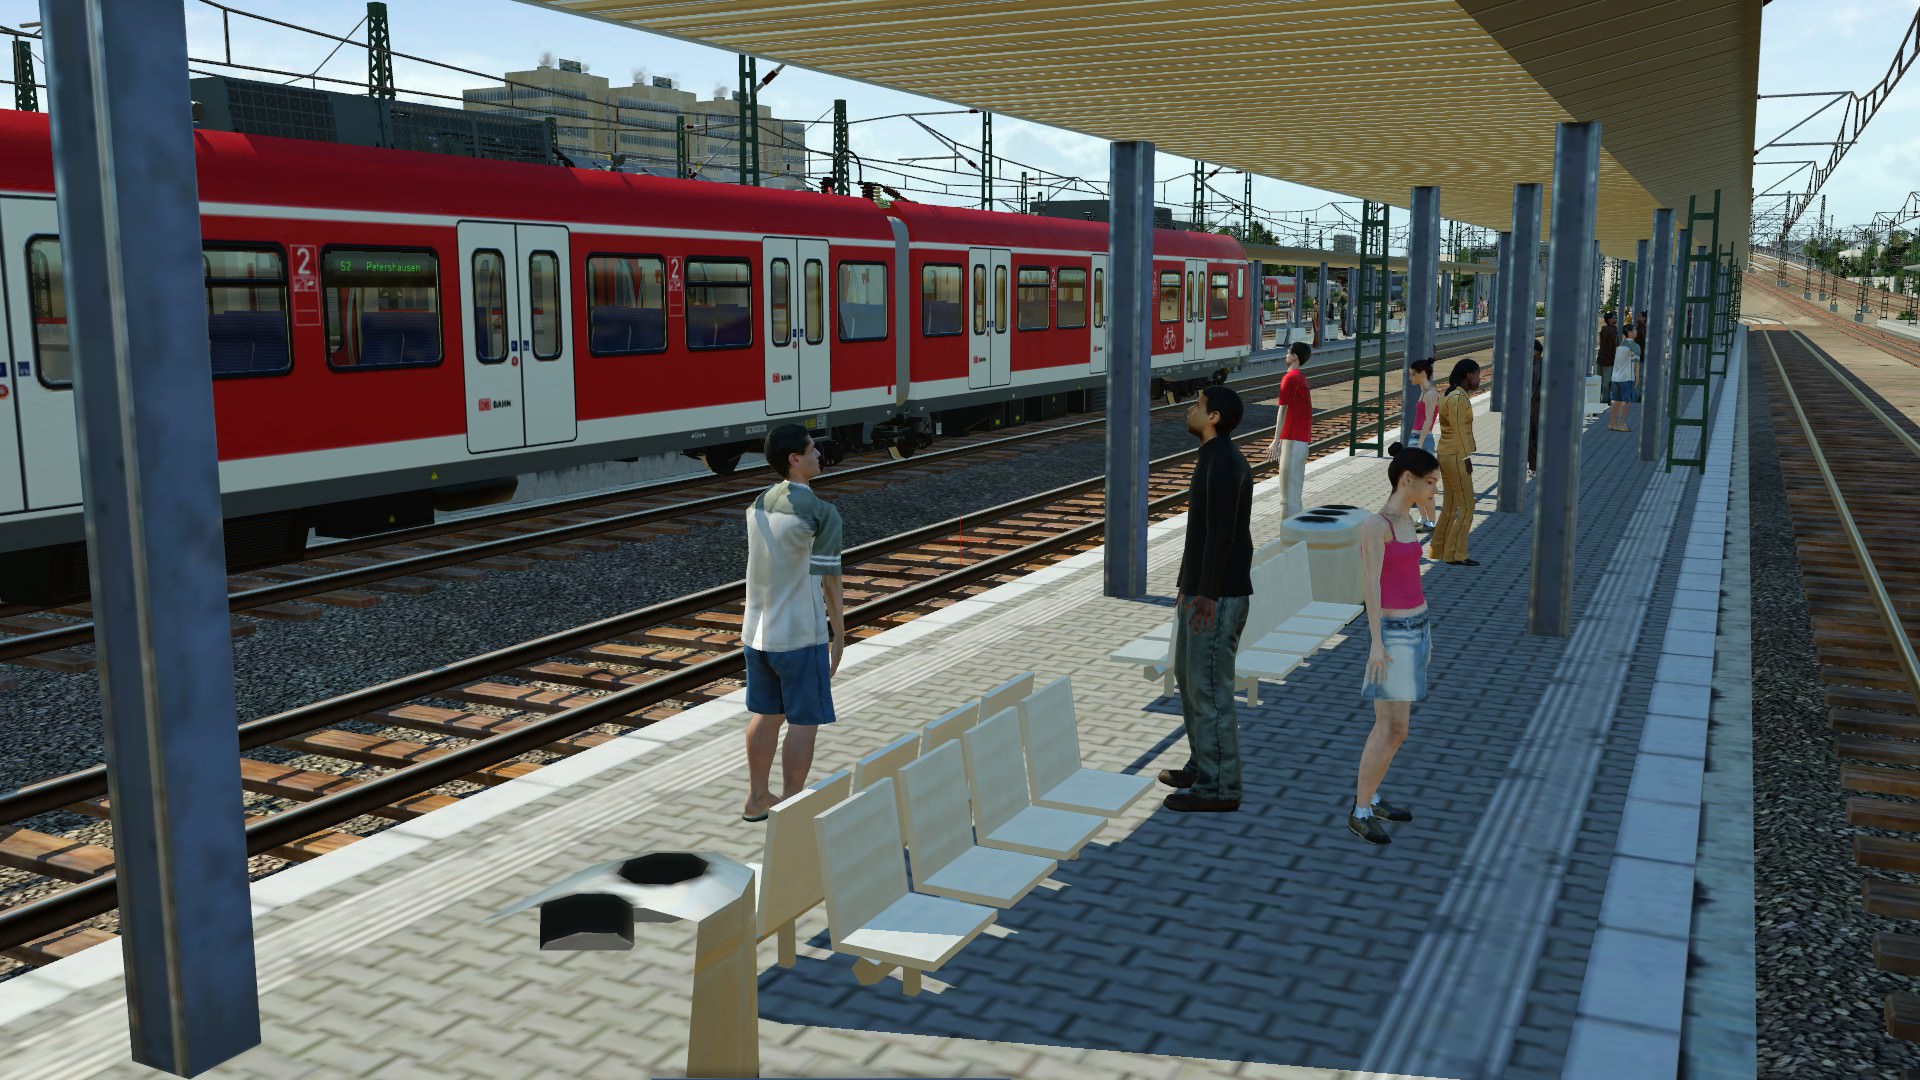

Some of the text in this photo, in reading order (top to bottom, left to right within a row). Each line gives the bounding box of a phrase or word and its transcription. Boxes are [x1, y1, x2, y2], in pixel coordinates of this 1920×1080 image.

[297, 249, 310, 274] 2
[340, 261, 421, 272] S2 Petershausen
[671, 258, 679, 280] 2
